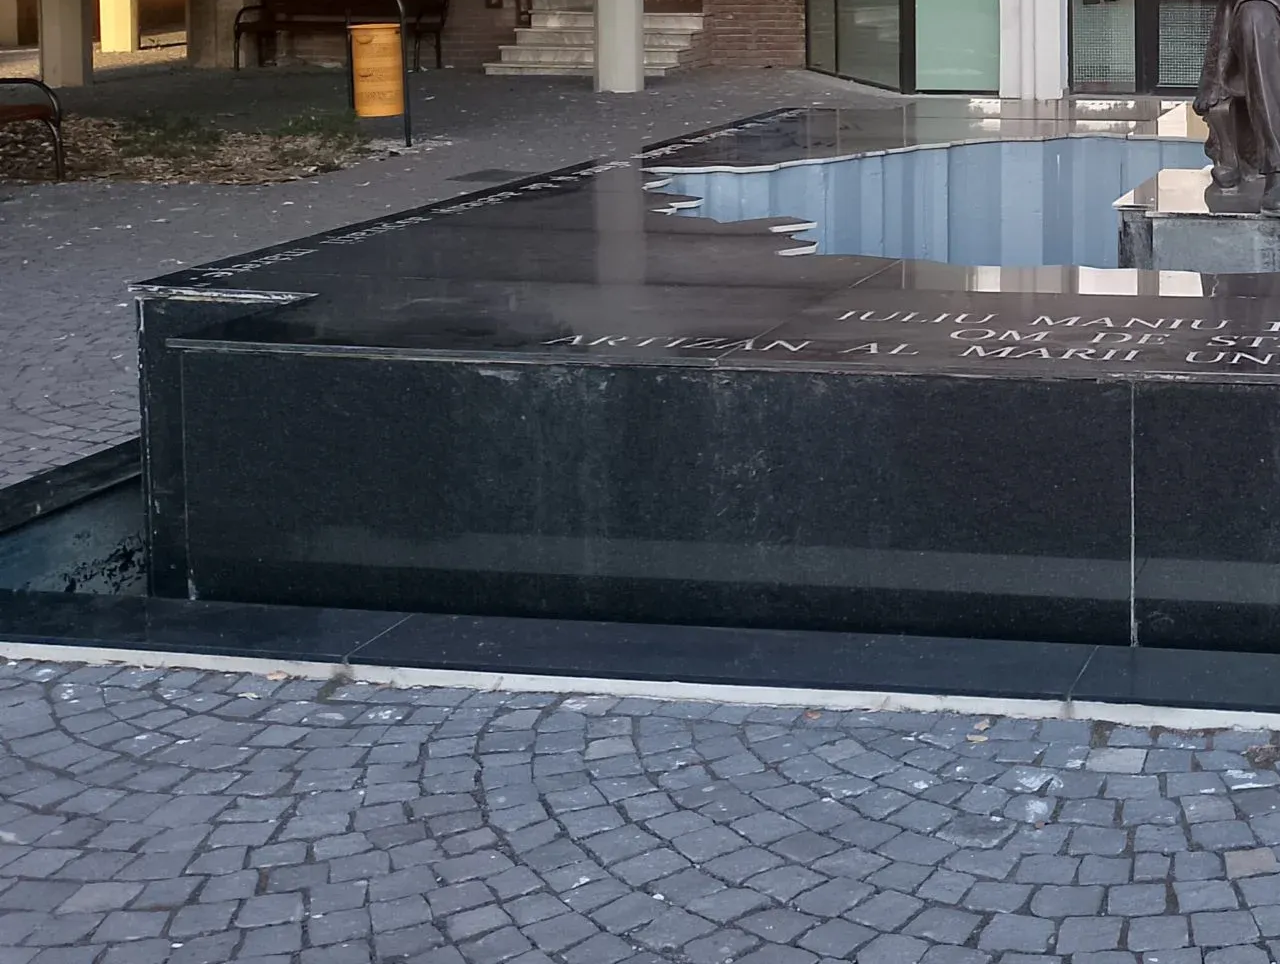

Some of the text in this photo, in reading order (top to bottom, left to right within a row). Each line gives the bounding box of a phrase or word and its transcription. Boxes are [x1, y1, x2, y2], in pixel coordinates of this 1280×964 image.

[835, 310, 999, 324] IULIU
[1027, 315, 1232, 331] MANIU
[949, 328, 1054, 342] OM
[1088, 332, 1171, 345] DE
[540, 334, 816, 352] ARTIZAN
[837, 342, 920, 356] AL
[957, 344, 1143, 362] MARII
